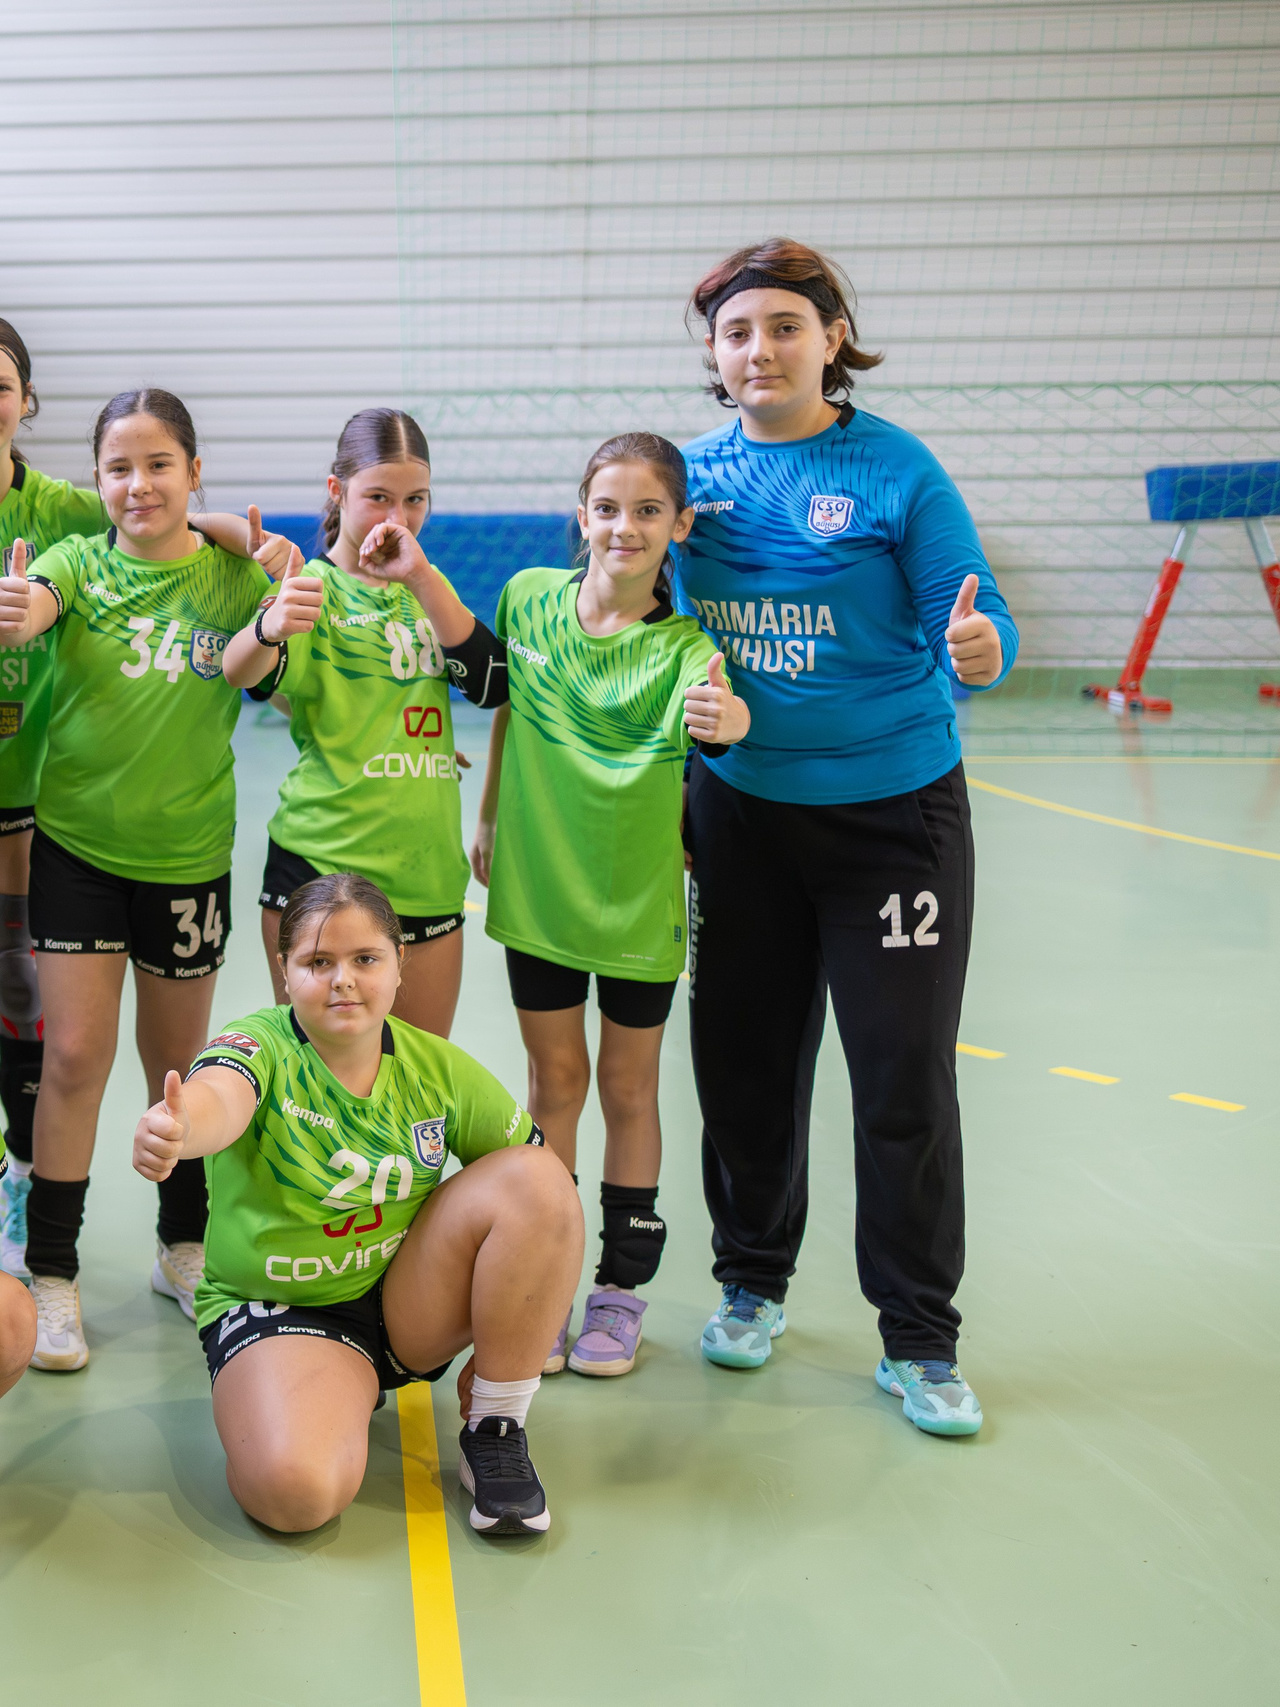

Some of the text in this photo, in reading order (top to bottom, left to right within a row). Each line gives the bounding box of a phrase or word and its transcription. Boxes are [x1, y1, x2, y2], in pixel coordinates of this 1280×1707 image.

[692, 499, 734, 515] Kempa
[817, 500, 846, 512] CSO
[84, 581, 122, 602] Kempa
[330, 613, 379, 629] Kempa
[120, 616, 186, 683] 34
[197, 635, 226, 652] CSO
[384, 617, 445, 680] 88
[506, 636, 549, 667] Kempa
[0, 816, 35, 832] Kempa
[170, 892, 223, 958] 34
[425, 917, 457, 938] Kempa
[878, 890, 940, 948] 12
[44, 939, 82, 952] Kempa
[95, 940, 125, 951] Kempa
[175, 964, 211, 978] Kempa
[217, 1057, 257, 1086] Kempa
[281, 1097, 335, 1130] Kempa
[320, 1148, 414, 1210] 20
[629, 1216, 664, 1232] Kempa
[277, 1325, 326, 1336] Kempa
[224, 1332, 261, 1361] Kempa
